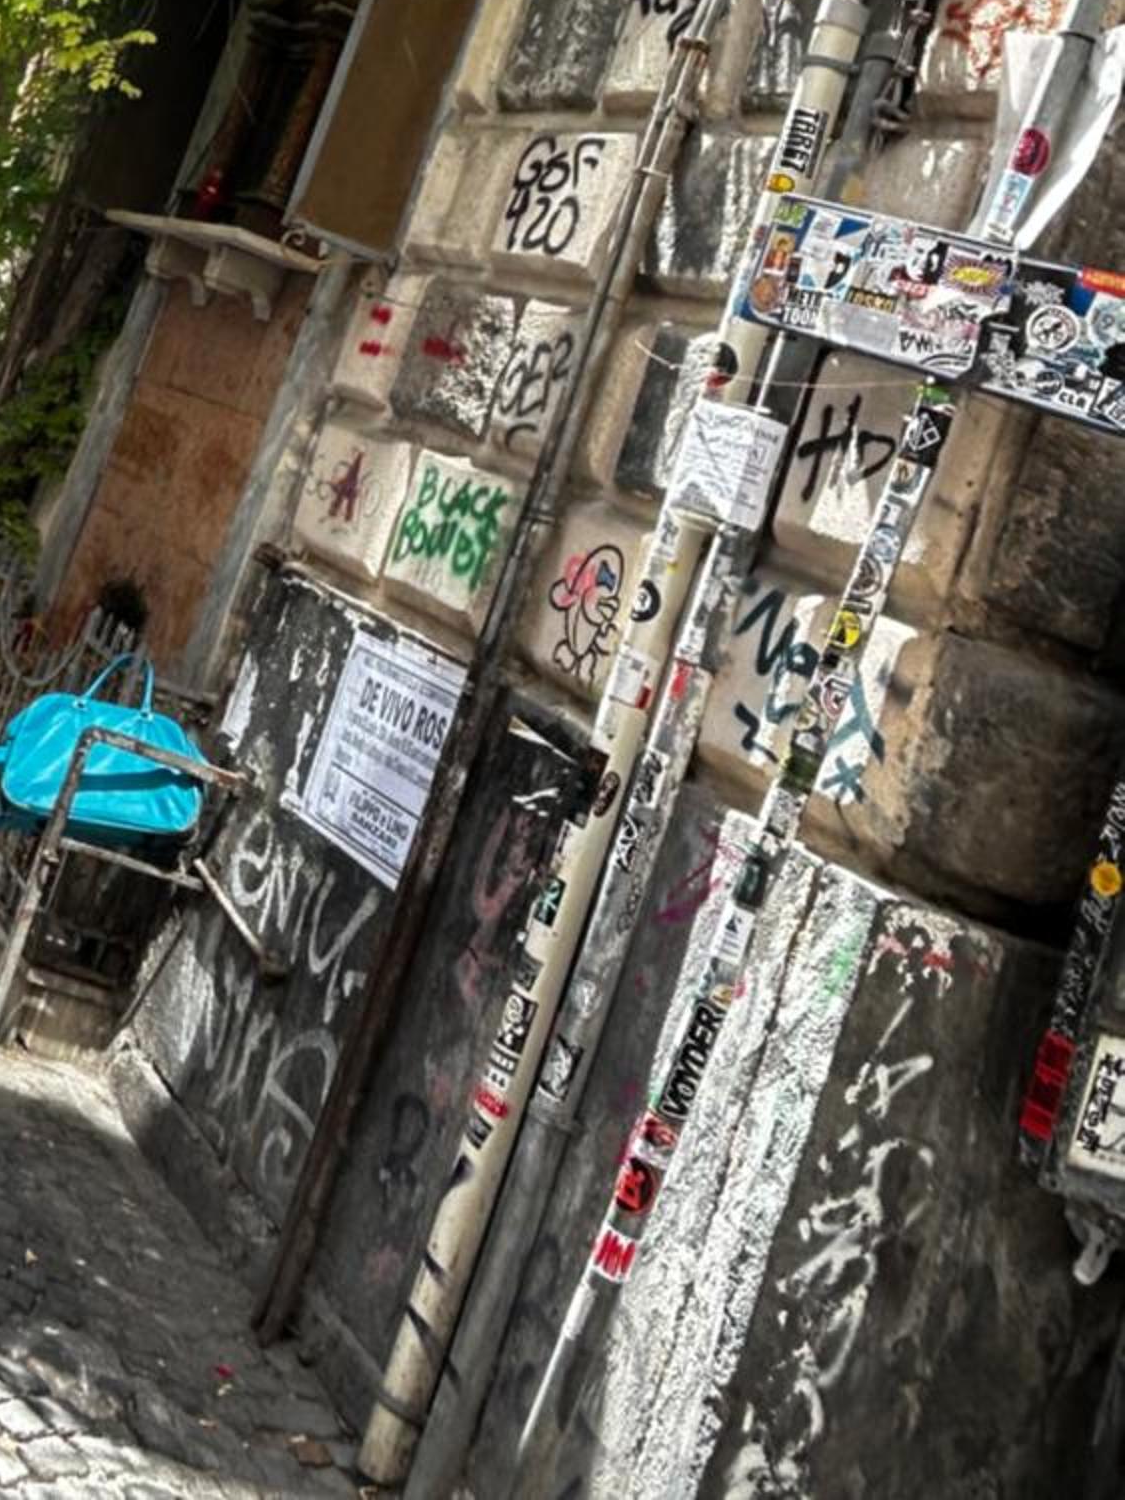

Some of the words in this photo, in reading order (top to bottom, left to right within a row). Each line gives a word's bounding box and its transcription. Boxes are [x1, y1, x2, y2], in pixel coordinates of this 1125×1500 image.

[417, 466, 509, 524] BLACK
[359, 678, 379, 716] DE
[379, 685, 416, 733] VIVO
[662, 1005, 724, 1117] VOYDER
